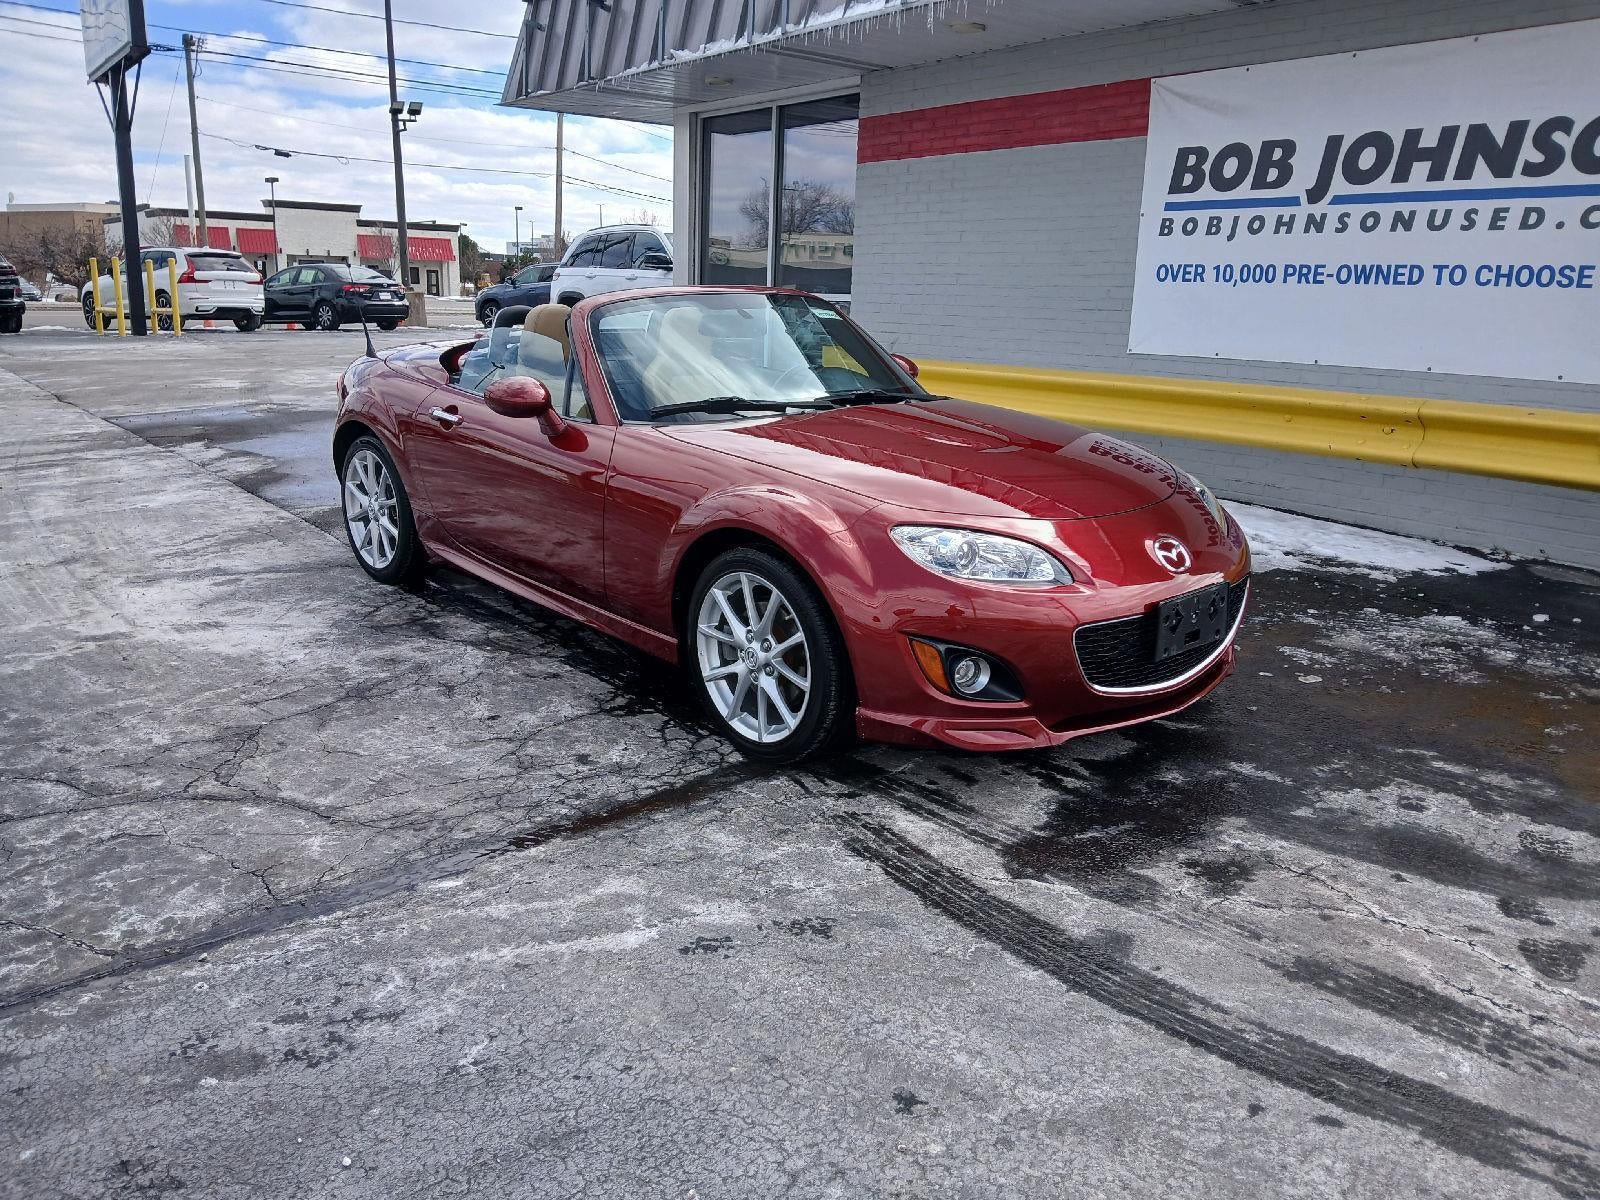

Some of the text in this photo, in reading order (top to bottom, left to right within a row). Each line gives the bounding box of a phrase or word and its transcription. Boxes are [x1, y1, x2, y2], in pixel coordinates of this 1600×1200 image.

[1168, 139, 1297, 195] BOB
[1156, 263, 1596, 289] OVER 10,000 PRE-OWNED TO CHOOSE
